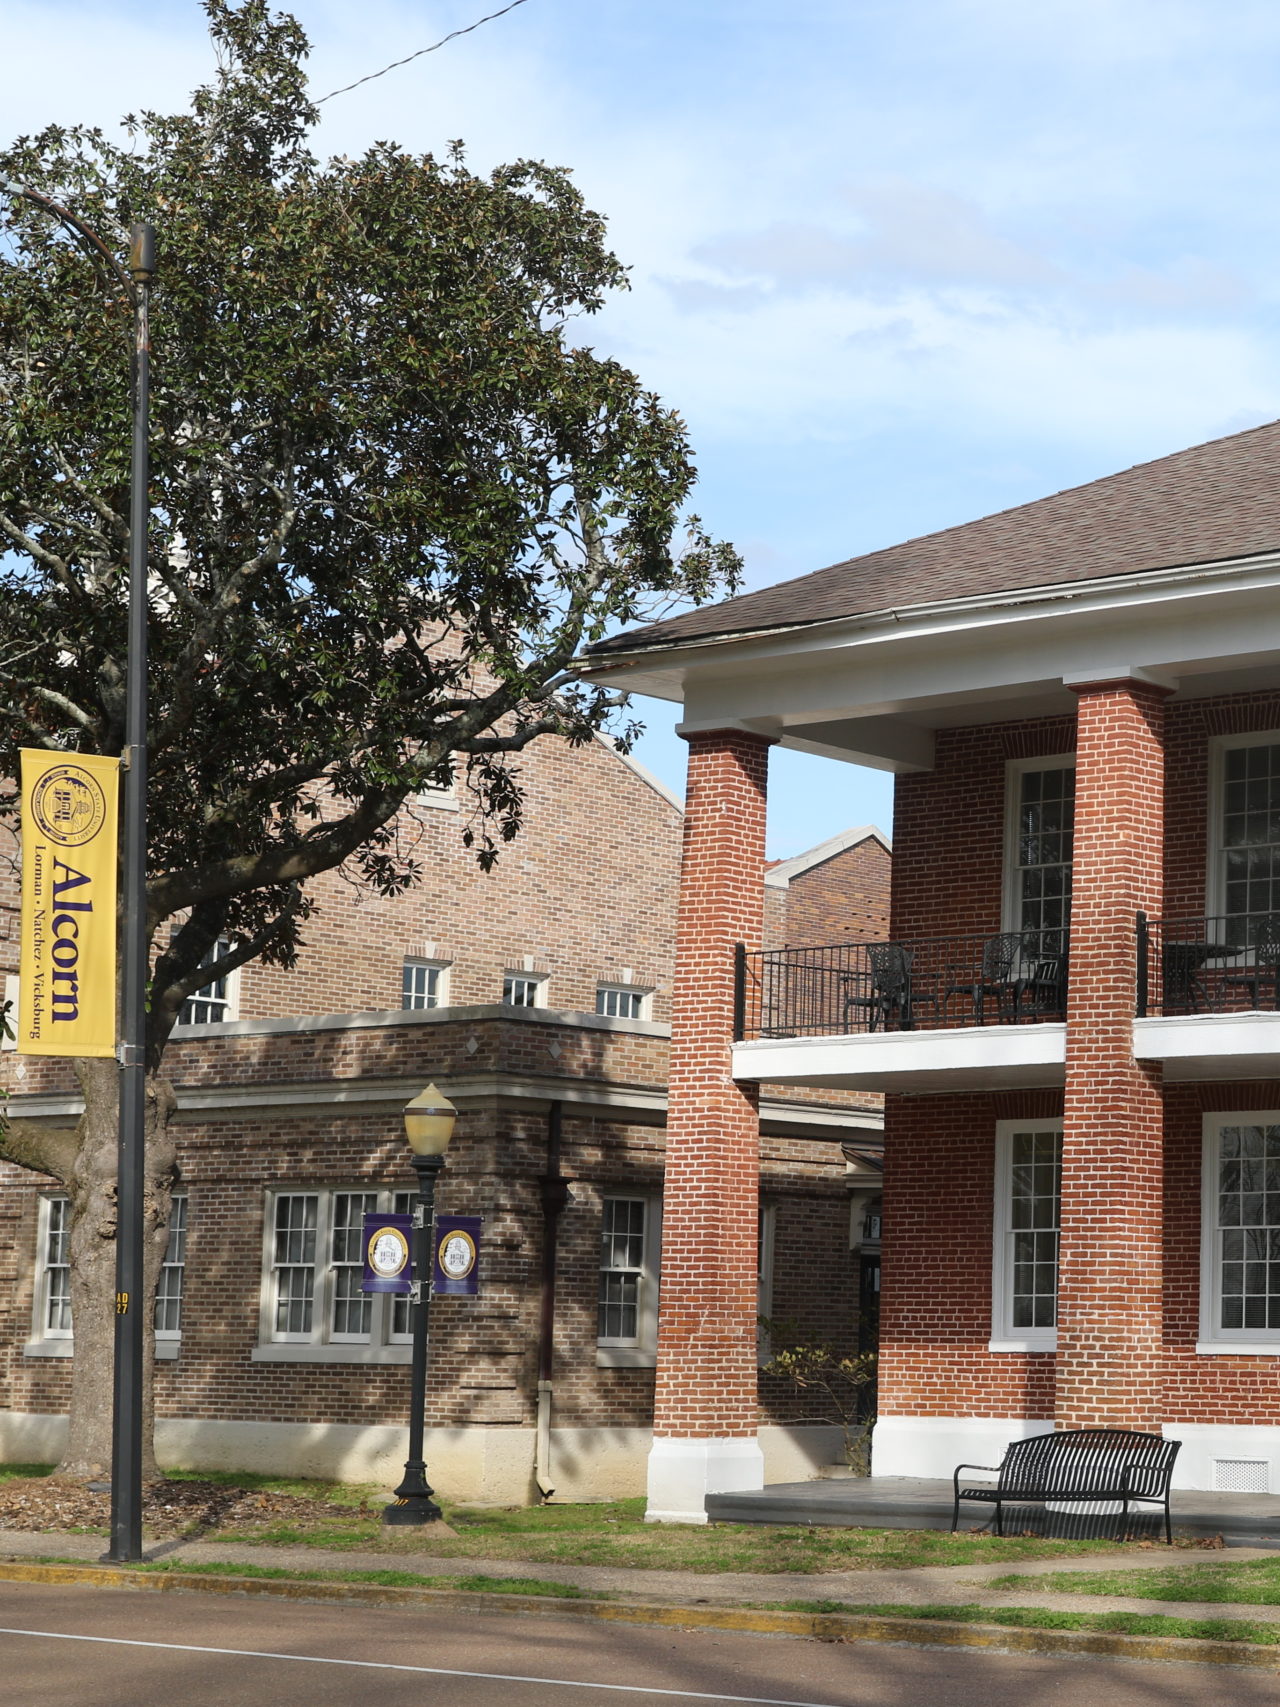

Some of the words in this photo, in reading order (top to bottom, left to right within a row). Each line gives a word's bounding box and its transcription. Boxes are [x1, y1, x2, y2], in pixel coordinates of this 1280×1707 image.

[34, 845, 47, 896] Lorman
[33, 909, 46, 961] Natchez
[52, 856, 93, 1024] Alcorn
[29, 972, 45, 1040] Vicksburg
[116, 1303, 127, 1314] 27
